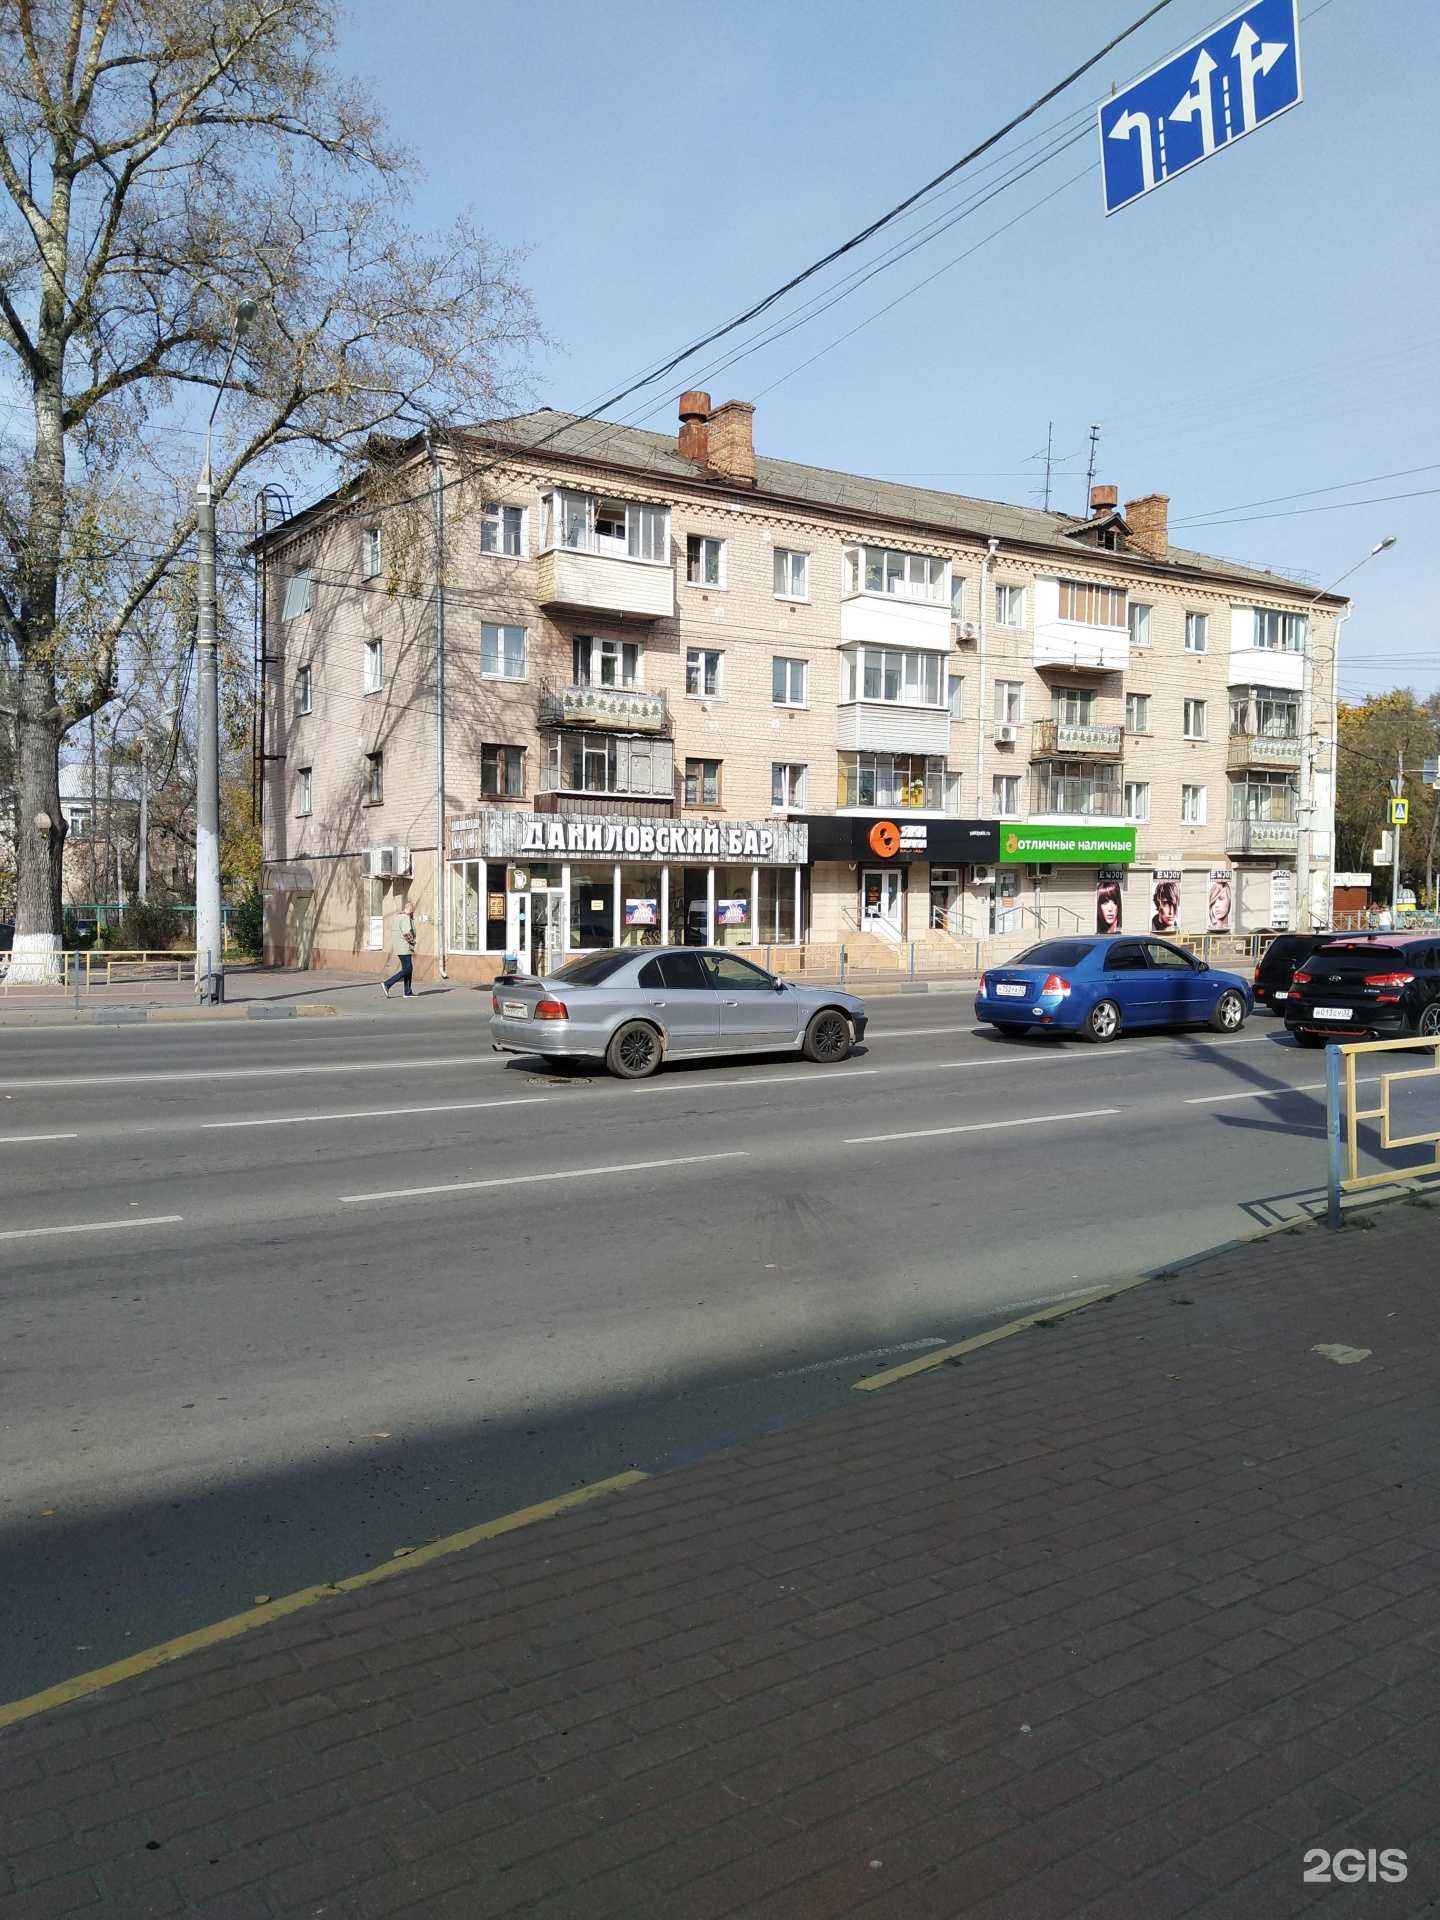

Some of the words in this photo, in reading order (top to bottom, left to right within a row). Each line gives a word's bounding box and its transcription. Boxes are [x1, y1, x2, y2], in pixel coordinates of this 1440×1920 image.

[521, 820, 719, 855] ДАНИЛОВСКИЙ
[727, 828, 773, 856] БАР
[1017, 839, 1076, 850] отличные
[1077, 840, 1133, 851] наличные
[1099, 871, 1124, 879] ENJOY
[1156, 871, 1181, 879] ENJOY
